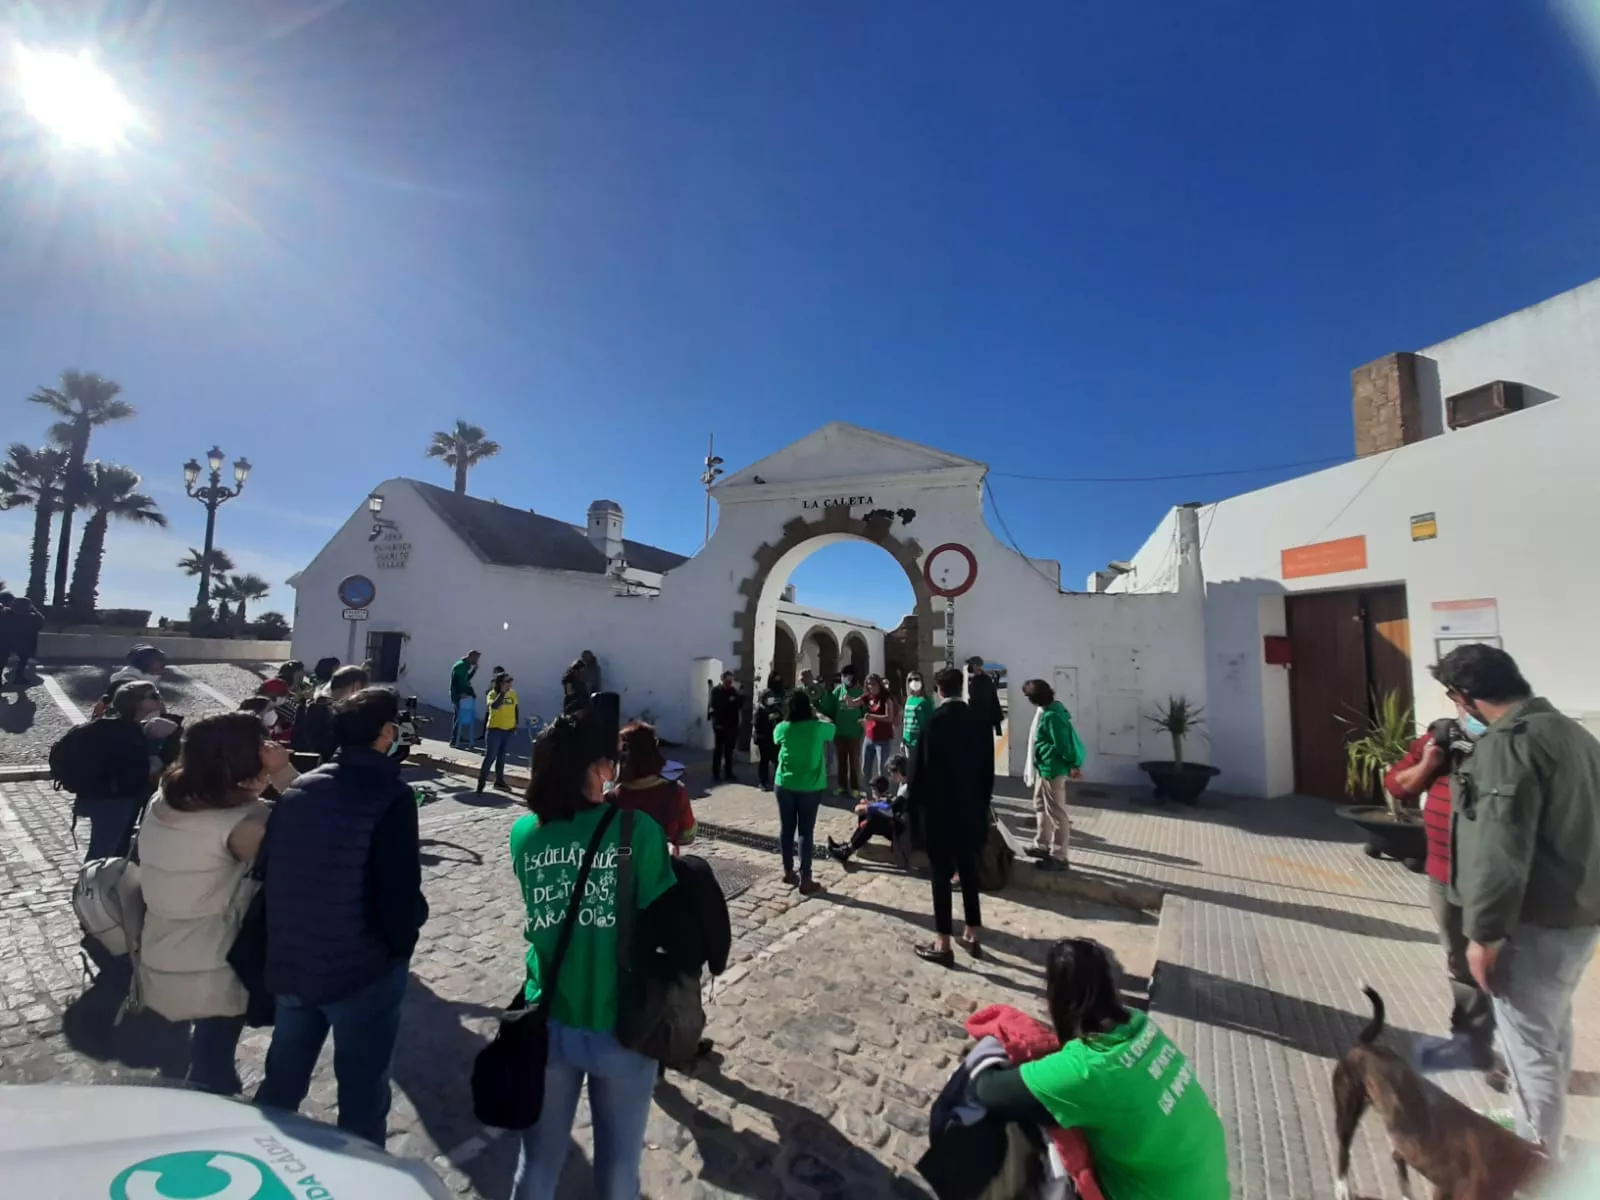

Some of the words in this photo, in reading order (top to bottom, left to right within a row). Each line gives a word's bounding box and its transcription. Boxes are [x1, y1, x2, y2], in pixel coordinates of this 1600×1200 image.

[803, 500, 819, 509] LA
[823, 496, 874, 508] CALETA
[524, 847, 576, 872] ESCUELA
[576, 848, 618, 871] PBLIC
[533, 885, 561, 904] DE
[560, 880, 609, 901] TDS
[253, 1135, 308, 1173] CÁDIZ
